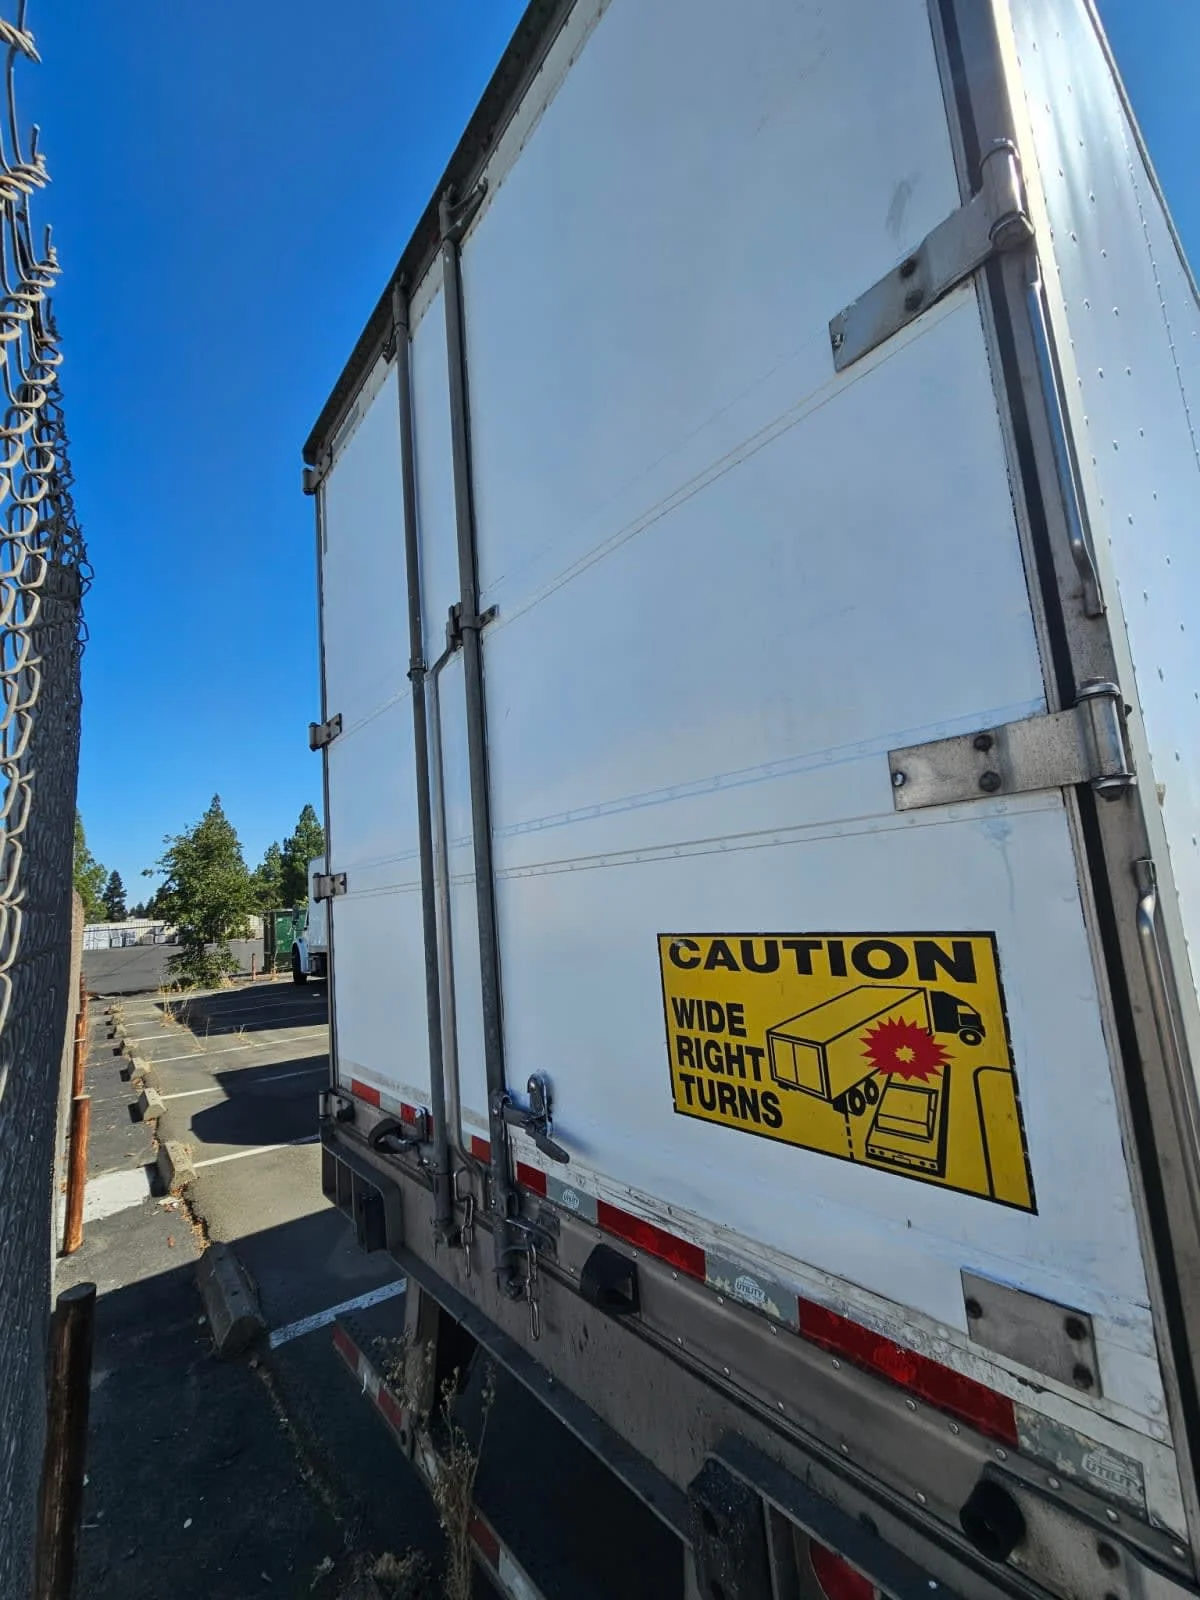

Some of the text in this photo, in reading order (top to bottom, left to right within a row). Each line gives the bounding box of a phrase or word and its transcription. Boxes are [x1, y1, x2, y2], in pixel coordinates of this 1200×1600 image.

[669, 939, 978, 983] CAUTION
[671, 997, 747, 1037] WIDE
[676, 1035, 765, 1081] RIGHT
[679, 1073, 783, 1128] TURNS
[736, 1281, 764, 1298] UTILITY
